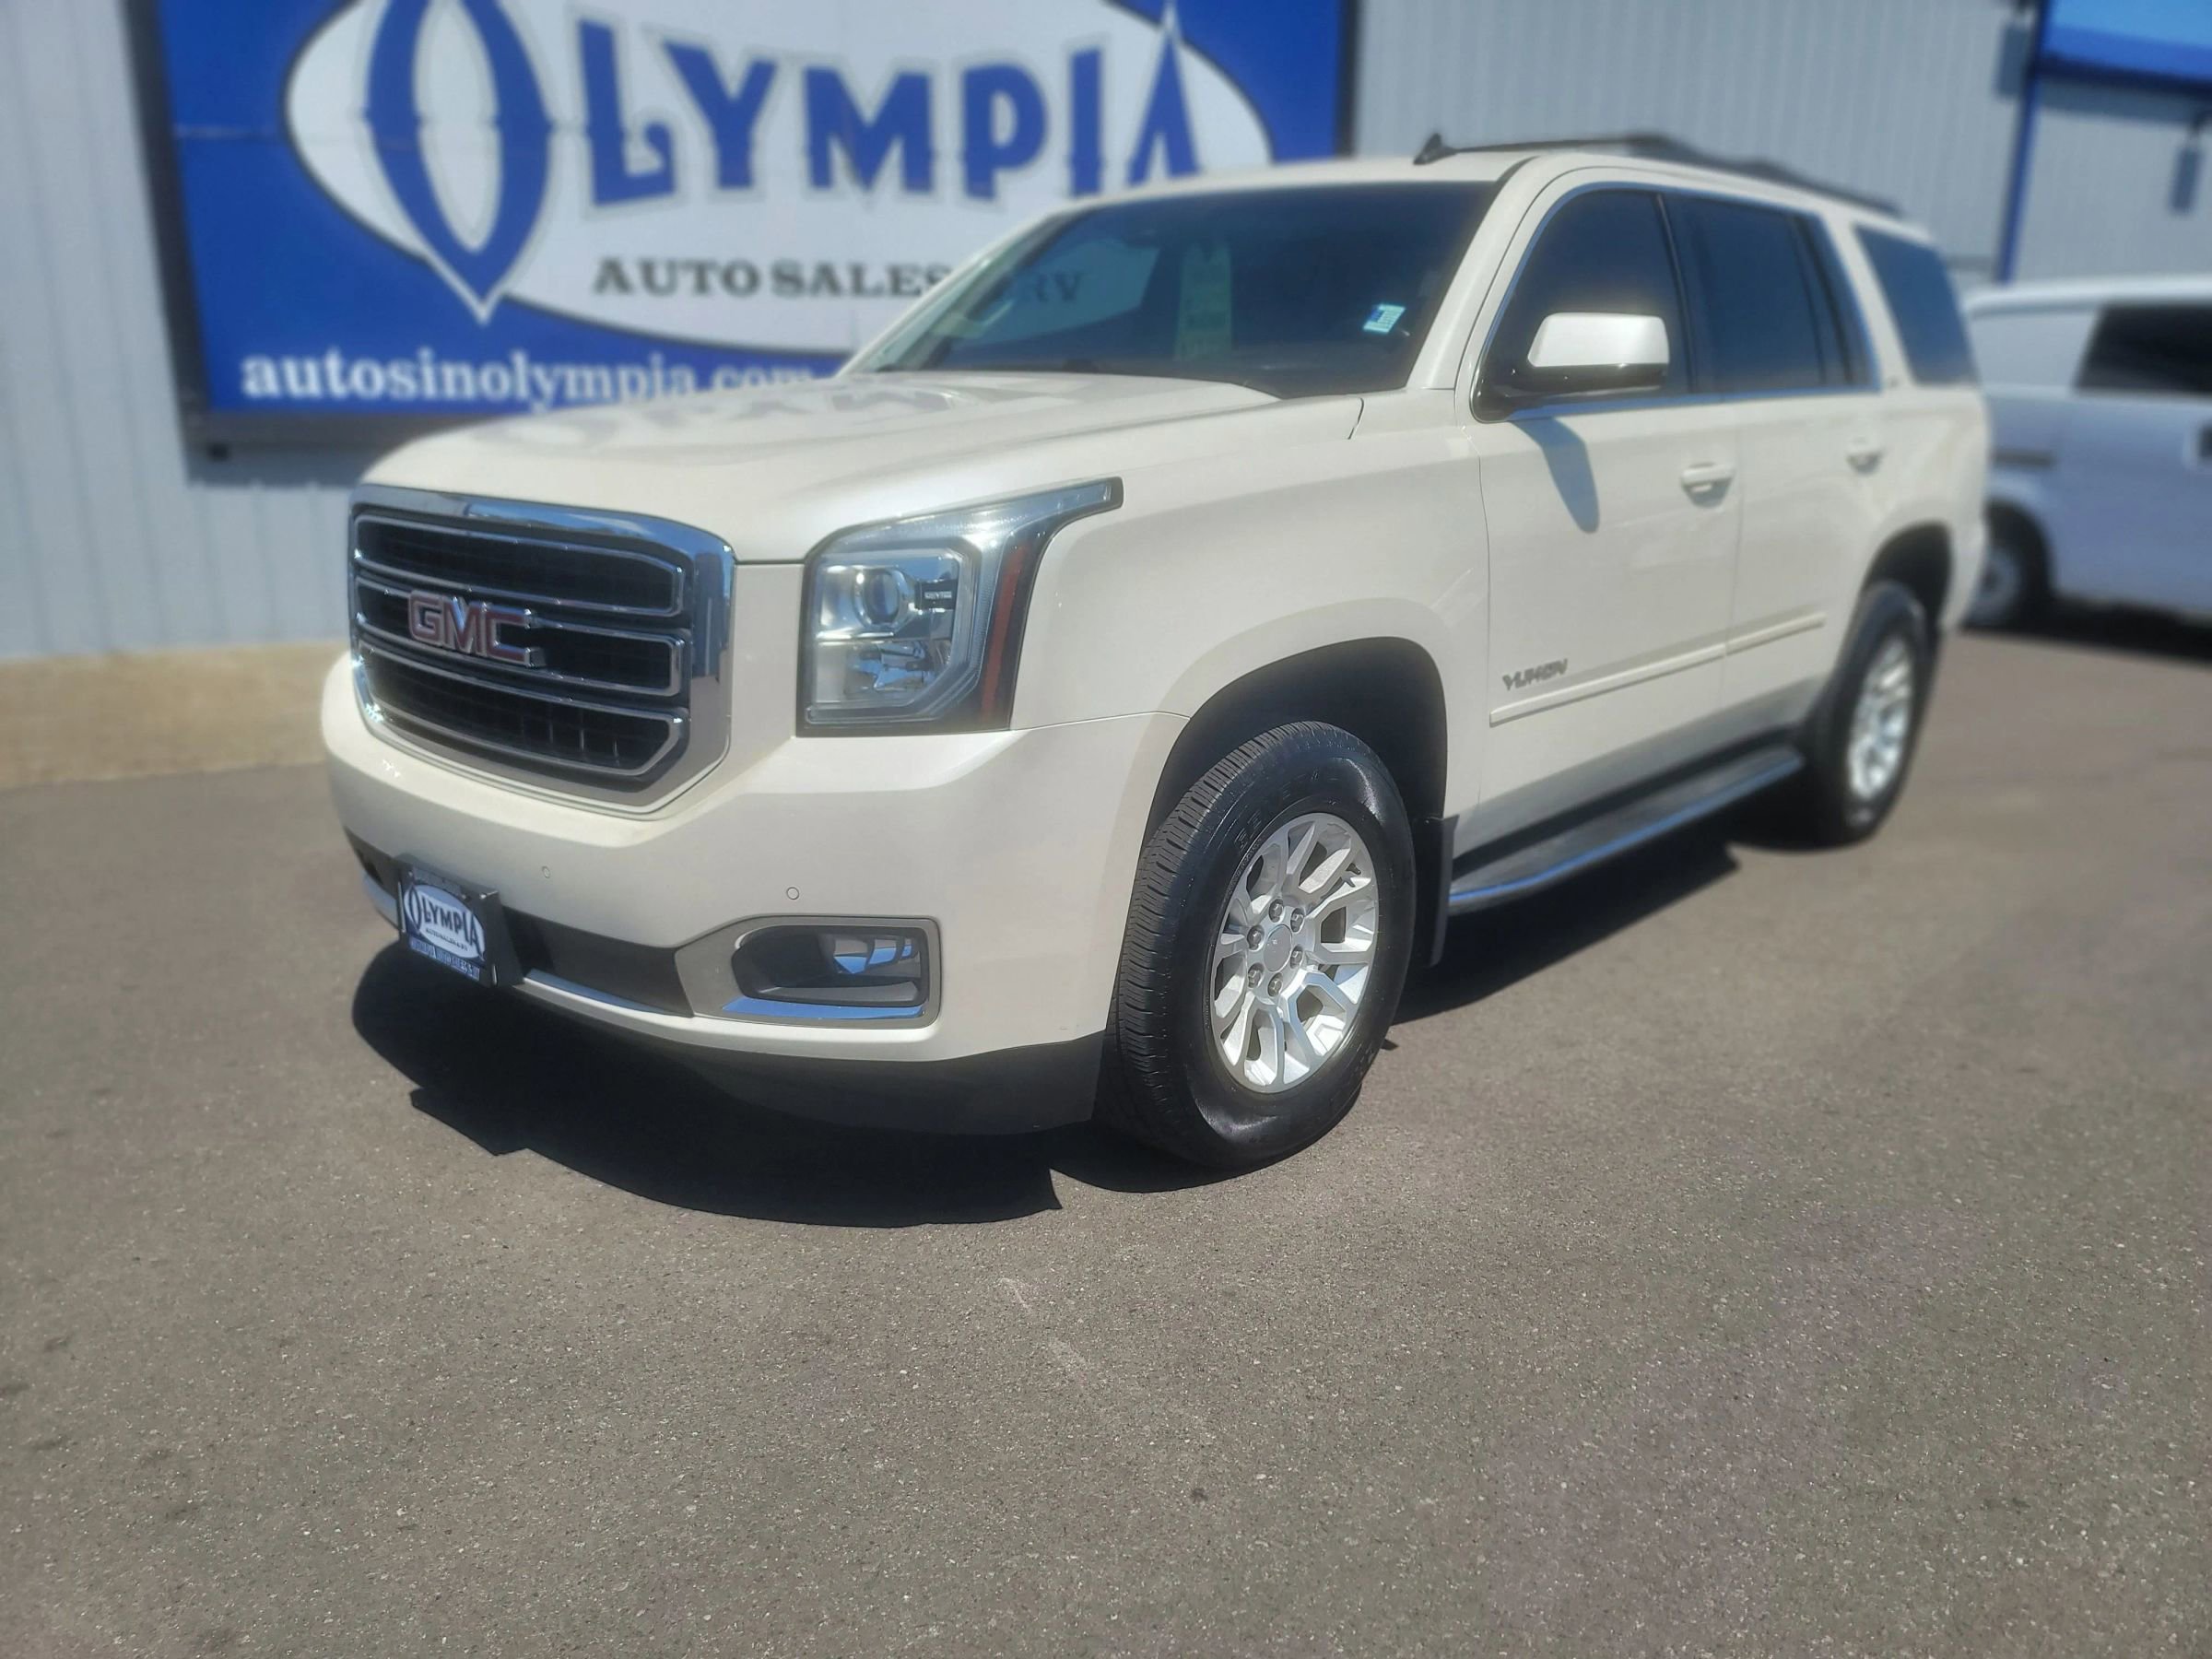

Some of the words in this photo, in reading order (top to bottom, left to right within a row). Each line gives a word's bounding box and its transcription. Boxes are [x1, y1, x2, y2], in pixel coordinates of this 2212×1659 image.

[364, 0, 1203, 300] OLYMPIA
[594, 259, 760, 295] AUTO
[241, 347, 815, 411] autosinolympiaco
[407, 590, 538, 666] GMC
[406, 885, 485, 959] OLYMPIA
